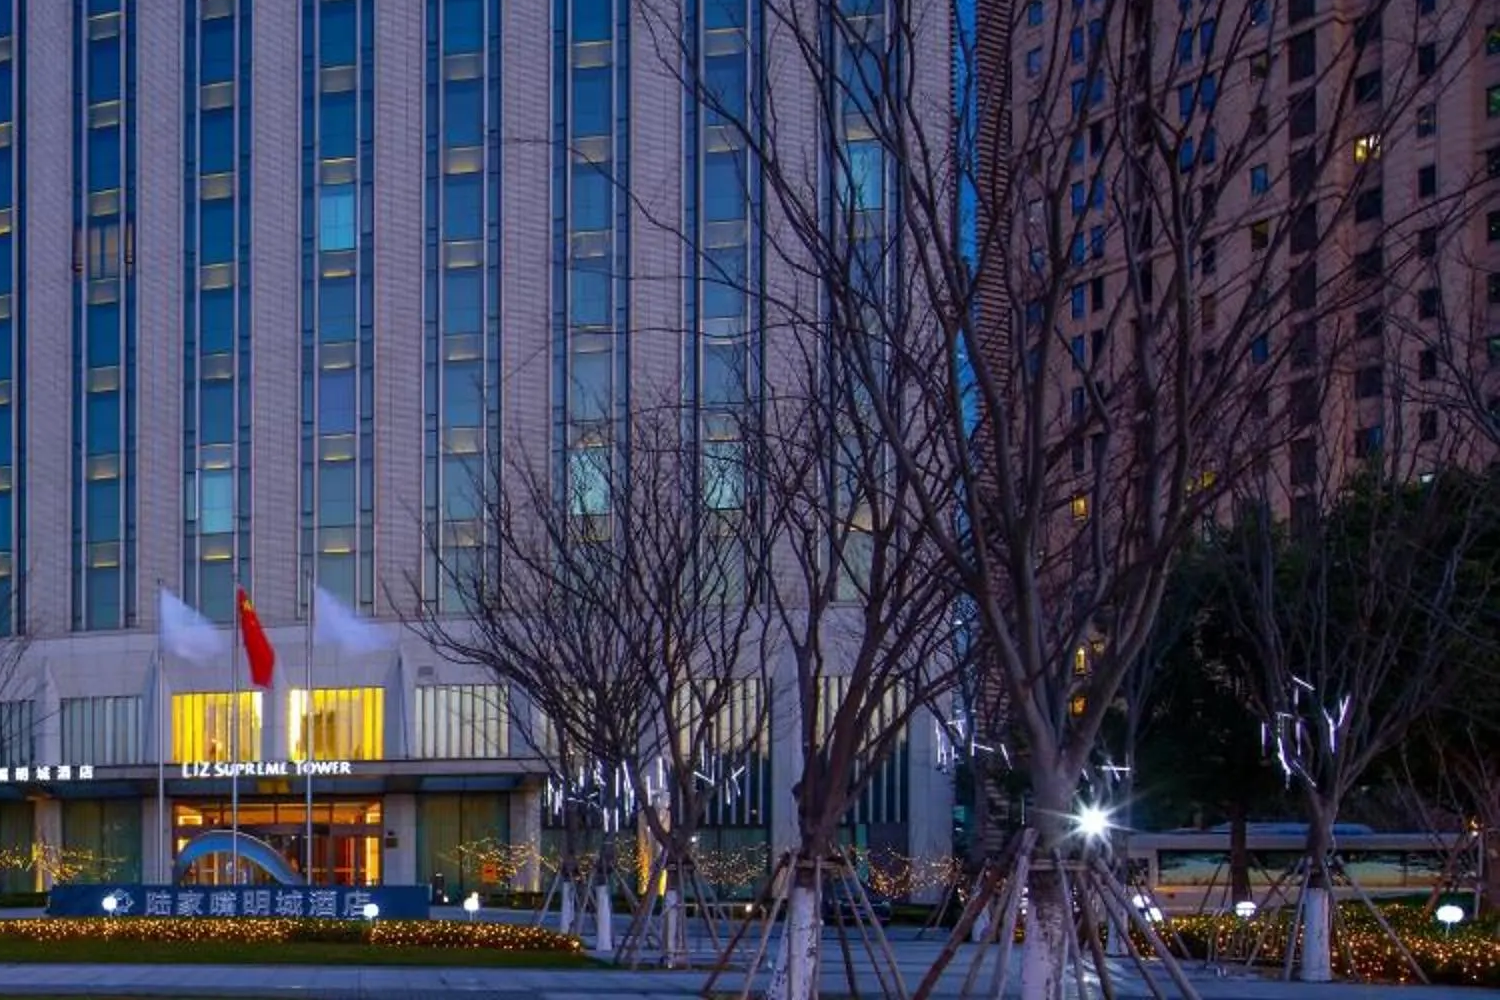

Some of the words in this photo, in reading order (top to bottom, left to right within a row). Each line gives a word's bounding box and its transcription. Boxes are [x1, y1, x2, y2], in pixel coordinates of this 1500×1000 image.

[214, 760, 288, 777] SUPREME
[296, 759, 352, 775] TOWER
[145, 889, 373, 918] 陆家嘴明城酒店
